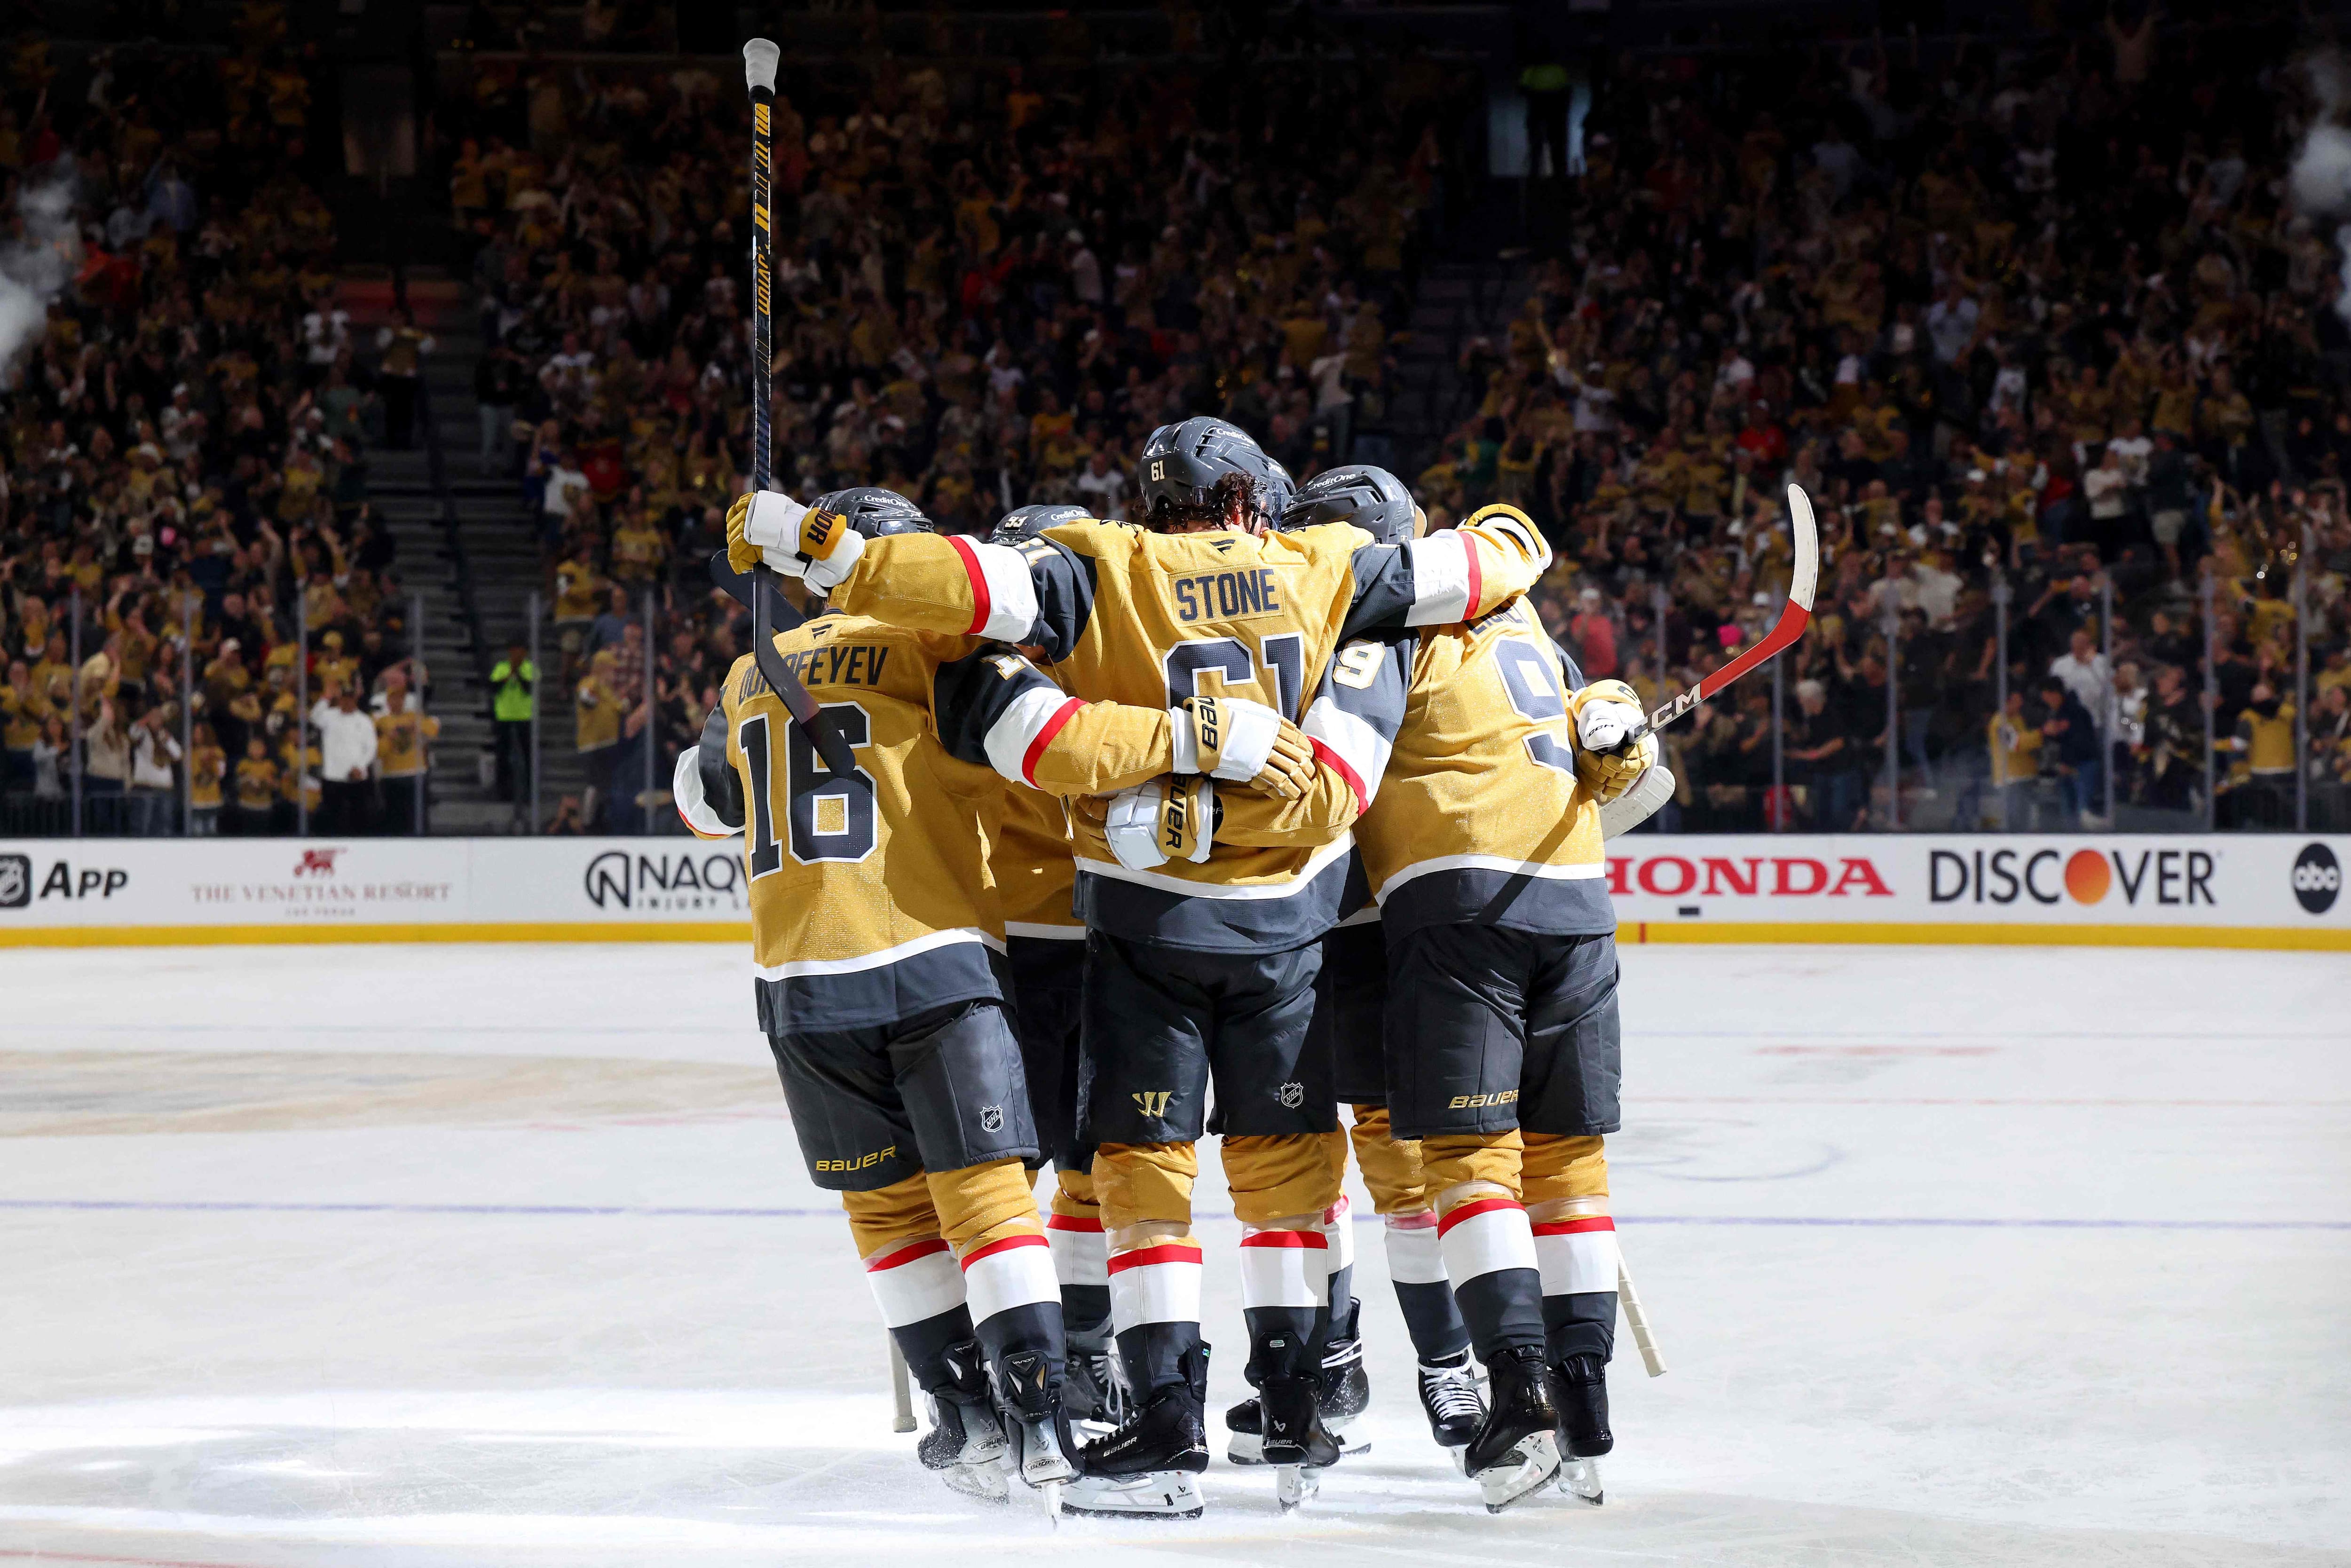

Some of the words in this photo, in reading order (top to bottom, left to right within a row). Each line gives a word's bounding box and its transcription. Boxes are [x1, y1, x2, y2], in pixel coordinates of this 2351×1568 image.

[1151, 460, 1165, 482] 61
[864, 495, 909, 509] CreditOne
[1004, 516, 1029, 528] 93
[1050, 509, 1087, 521] CreditOne
[1176, 568, 1279, 622] STONE
[1332, 638, 1386, 690] 9
[1491, 638, 1578, 783] 9
[1628, 683, 1702, 743] CCM
[1588, 724, 1614, 738] CCM
[738, 701, 878, 882] 16
[1930, 849, 2217, 906] DISCOVER
[2293, 860, 2340, 891] abc
[1286, 1090, 1299, 1103] NHL
[986, 1112, 1000, 1129] NHL
[1103, 1436, 1137, 1458] BAUER
